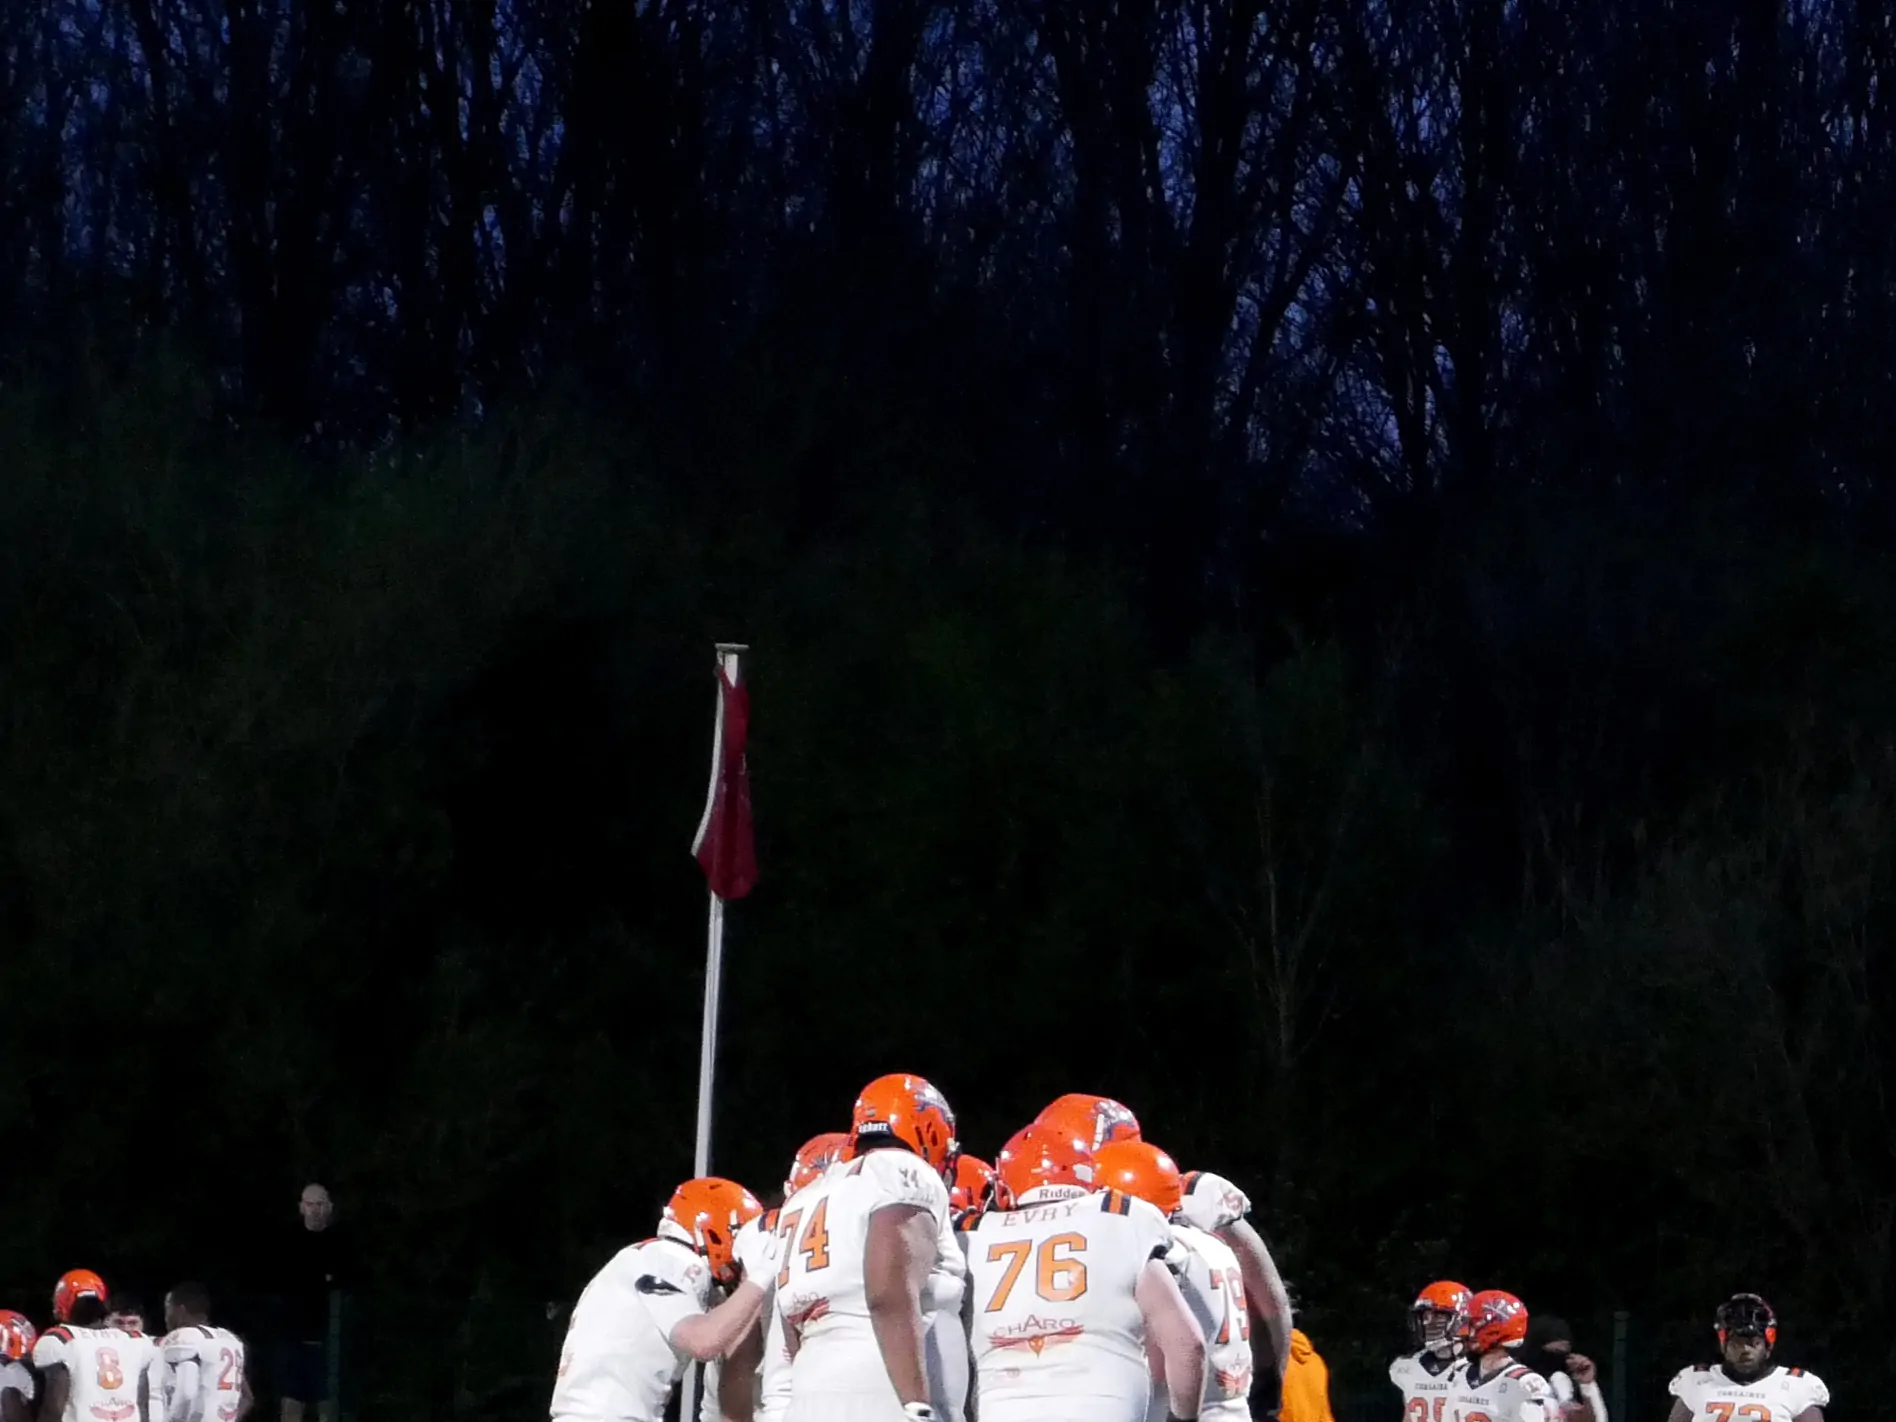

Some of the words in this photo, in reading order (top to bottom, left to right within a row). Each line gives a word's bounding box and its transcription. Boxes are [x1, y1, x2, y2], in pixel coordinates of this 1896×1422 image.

[778, 1195, 830, 1290] 74
[984, 1231, 1088, 1313] 76
[96, 1347, 123, 1390] 8
